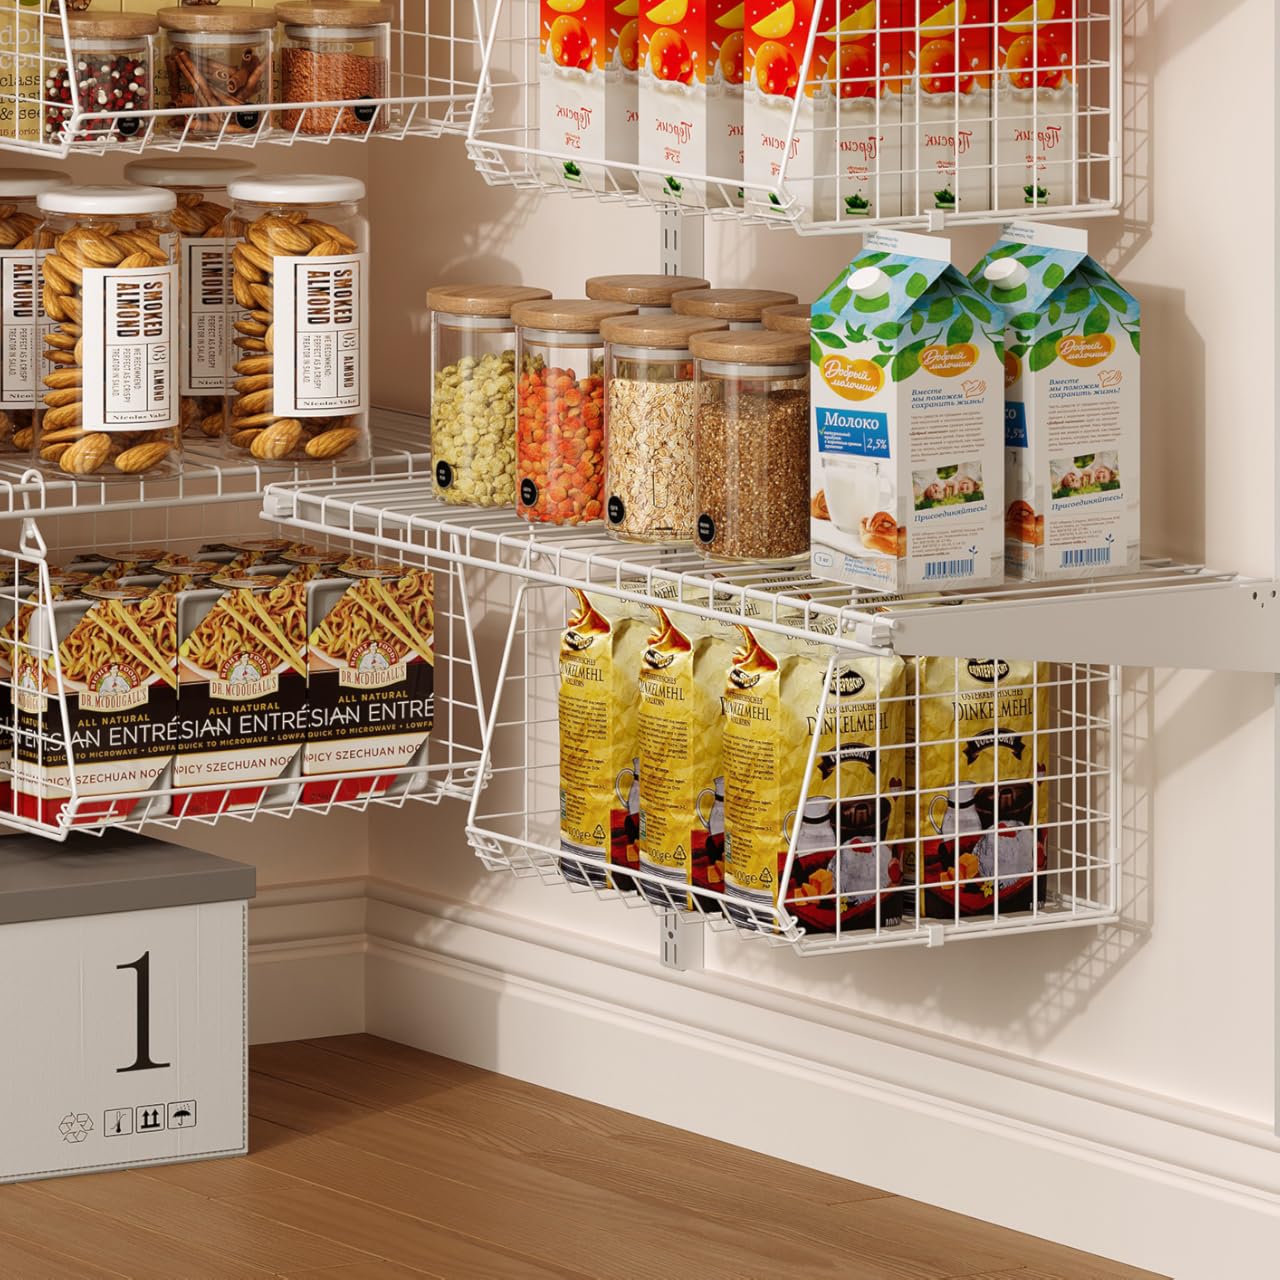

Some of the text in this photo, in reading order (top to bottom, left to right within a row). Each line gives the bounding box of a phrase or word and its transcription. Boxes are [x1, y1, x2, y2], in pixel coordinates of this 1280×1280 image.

[116, 282, 140, 338] ALMOND
[143, 281, 163, 337] SMOKED
[307, 270, 331, 325] ALMOND
[333, 269, 353, 325] SMOKED
[825, 411, 880, 431] Молоко
[866, 437, 887, 452] 2,5%
[338, 690, 409, 704] ALL NATURAL
[349, 724, 396, 734] MICROWAVE
[206, 758, 267, 772] SZECHUAN
[116, 950, 171, 1073] 1
